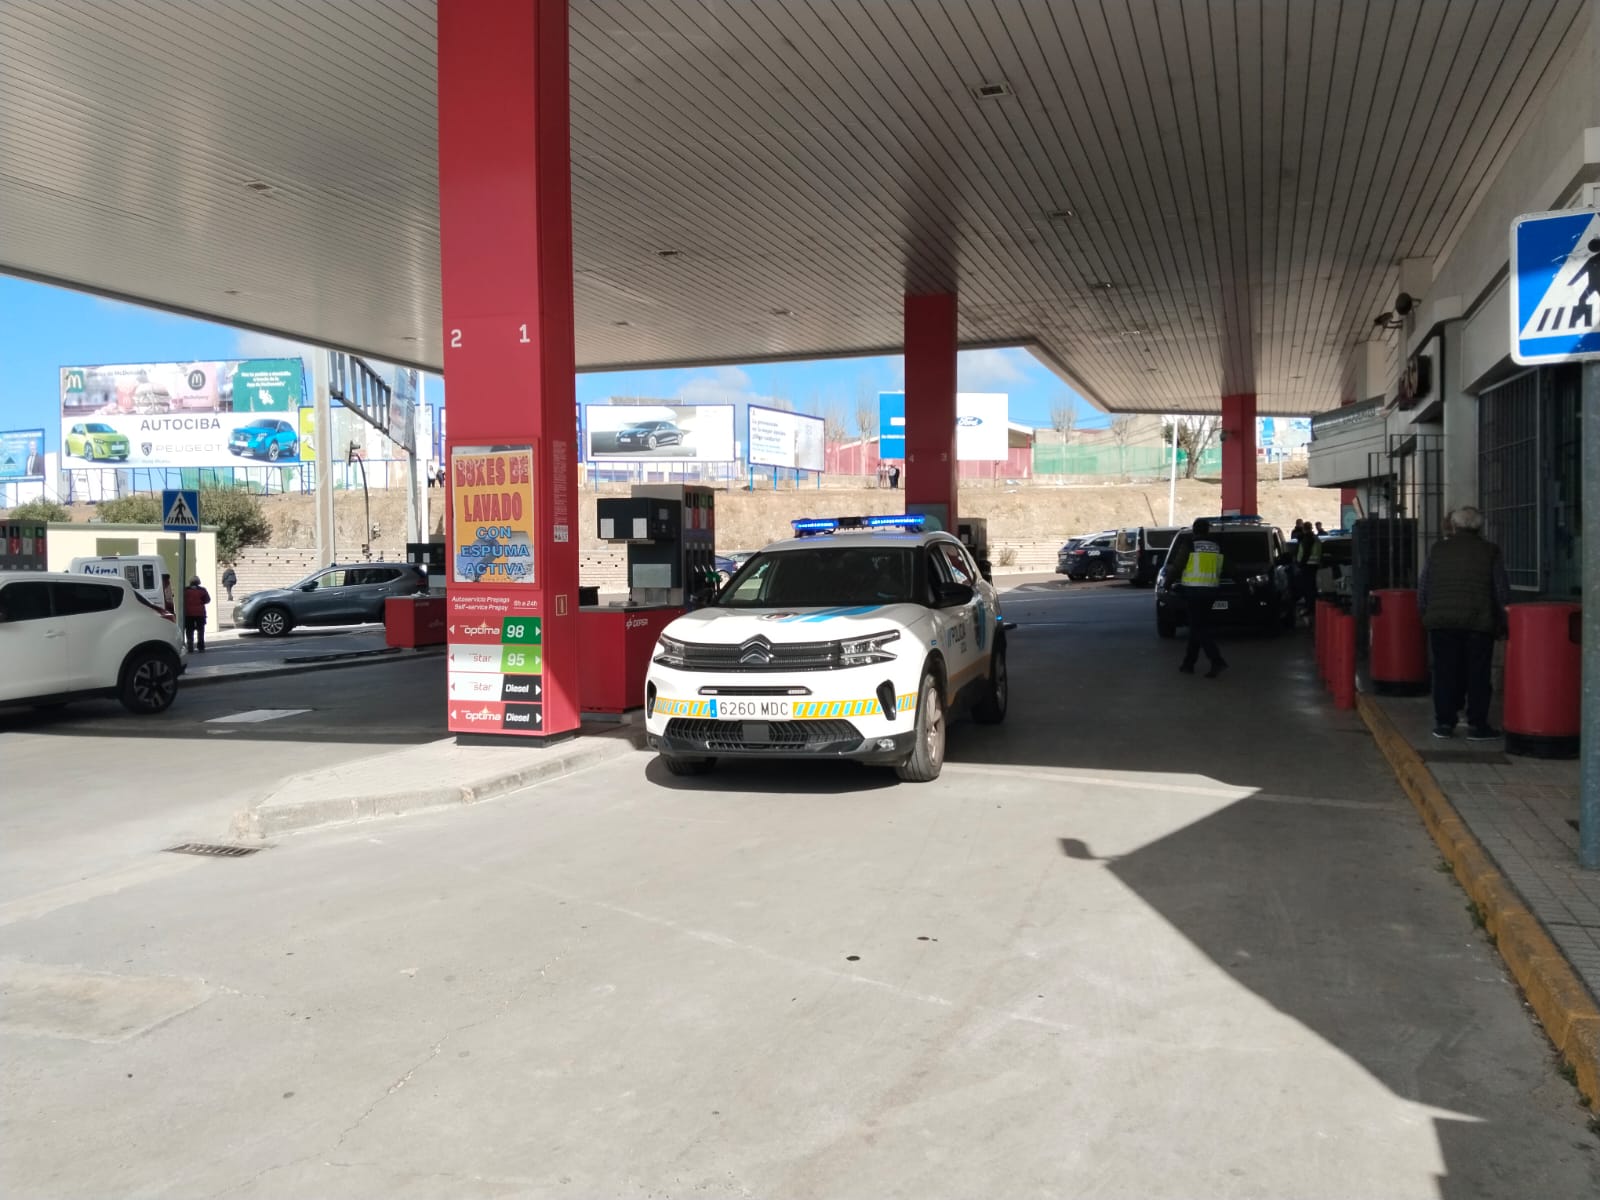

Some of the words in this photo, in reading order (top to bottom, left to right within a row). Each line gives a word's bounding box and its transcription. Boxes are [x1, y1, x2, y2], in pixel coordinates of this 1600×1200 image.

[451, 328, 463, 348] 2
[519, 323, 531, 344] 1
[140, 418, 221, 431] AUTOCIBA
[155, 443, 223, 453] PEUGEOT
[456, 457, 506, 488] BOXES
[509, 456, 529, 485] DE
[463, 492, 523, 523] LAVADO
[475, 526, 512, 540] CON
[460, 544, 530, 558] ESPUMA
[464, 562, 526, 576] ACTIVA
[506, 624, 525, 638] 98
[473, 654, 492, 663] star
[507, 653, 525, 667] 95
[473, 682, 493, 691] star
[505, 684, 530, 693] Diesel
[719, 701, 755, 716] 6260
[761, 702, 789, 716] MDC
[505, 713, 530, 722] Diesel
